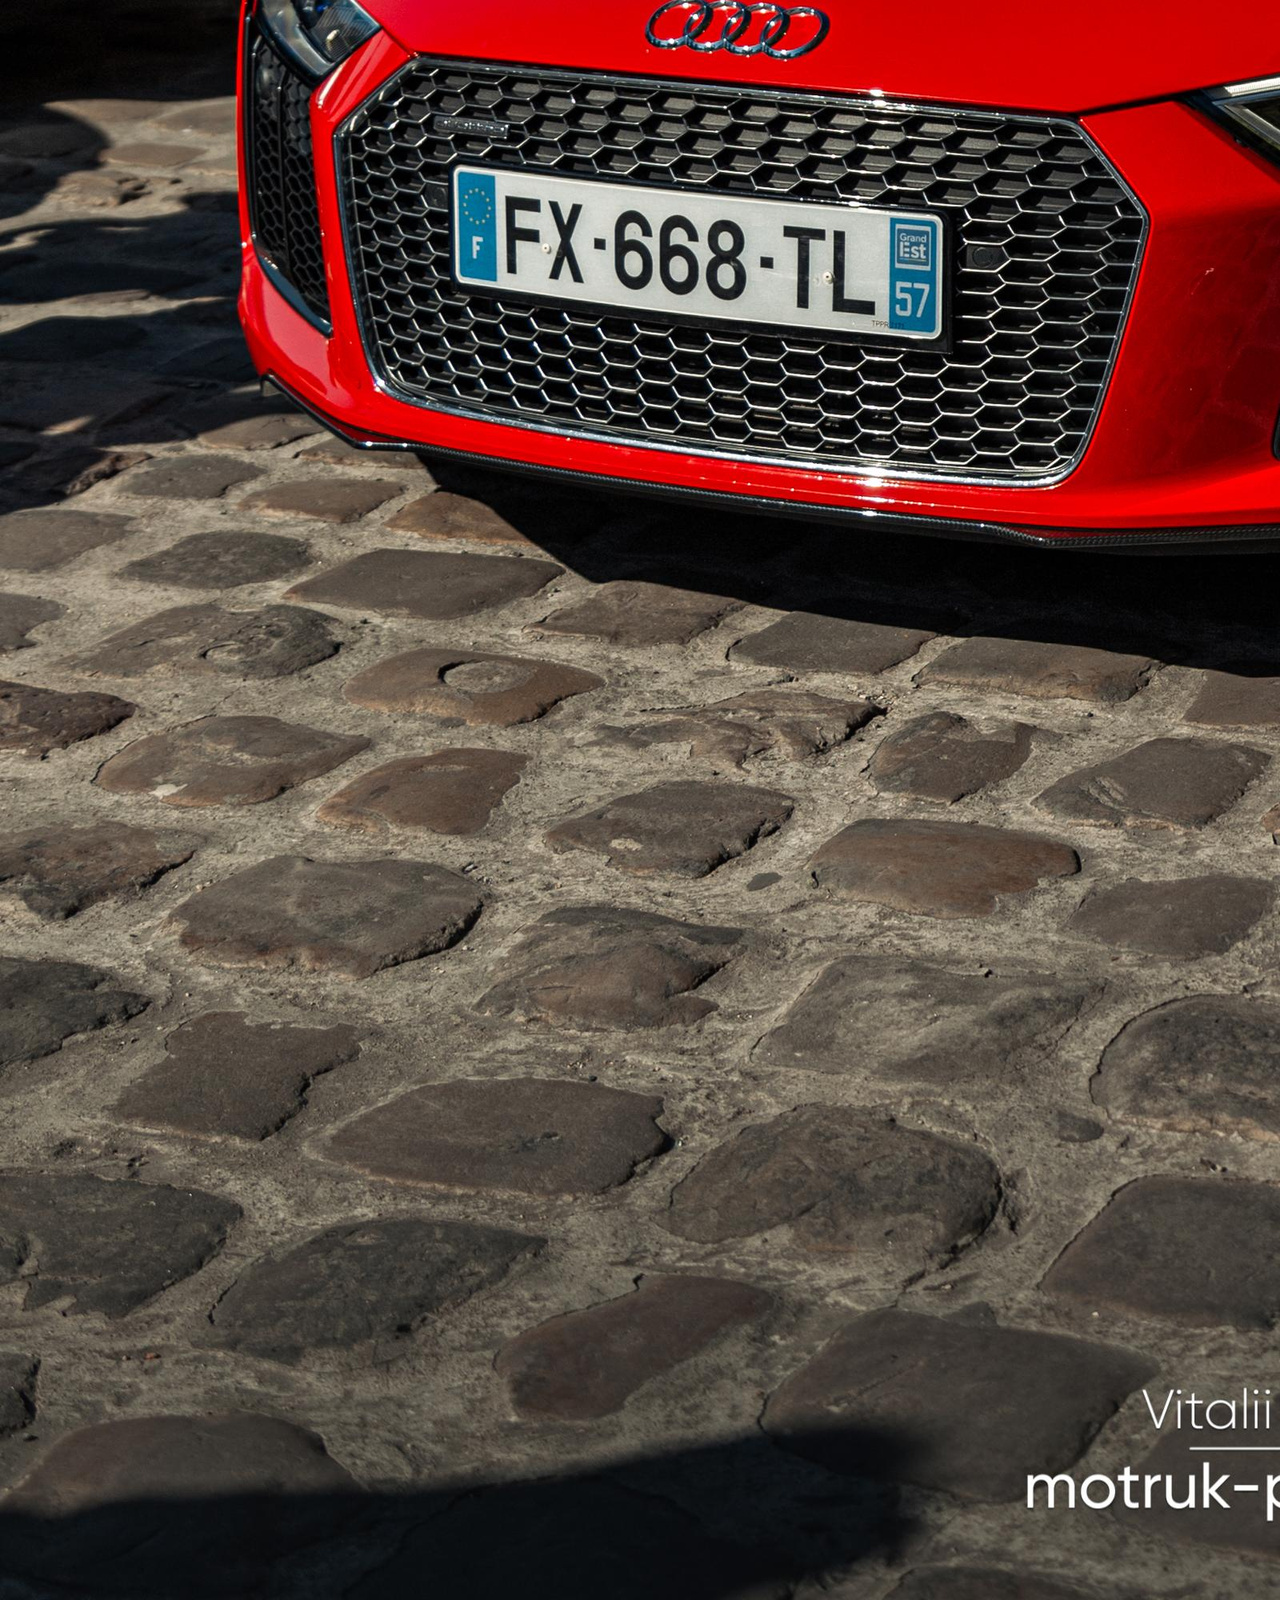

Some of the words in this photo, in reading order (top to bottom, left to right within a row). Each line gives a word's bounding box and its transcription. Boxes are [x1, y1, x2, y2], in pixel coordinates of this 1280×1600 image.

[472, 235, 484, 260] F
[899, 232, 928, 244] Grand
[900, 241, 927, 259] Est
[505, 195, 875, 316] FX-668-TL
[895, 281, 930, 318] 57
